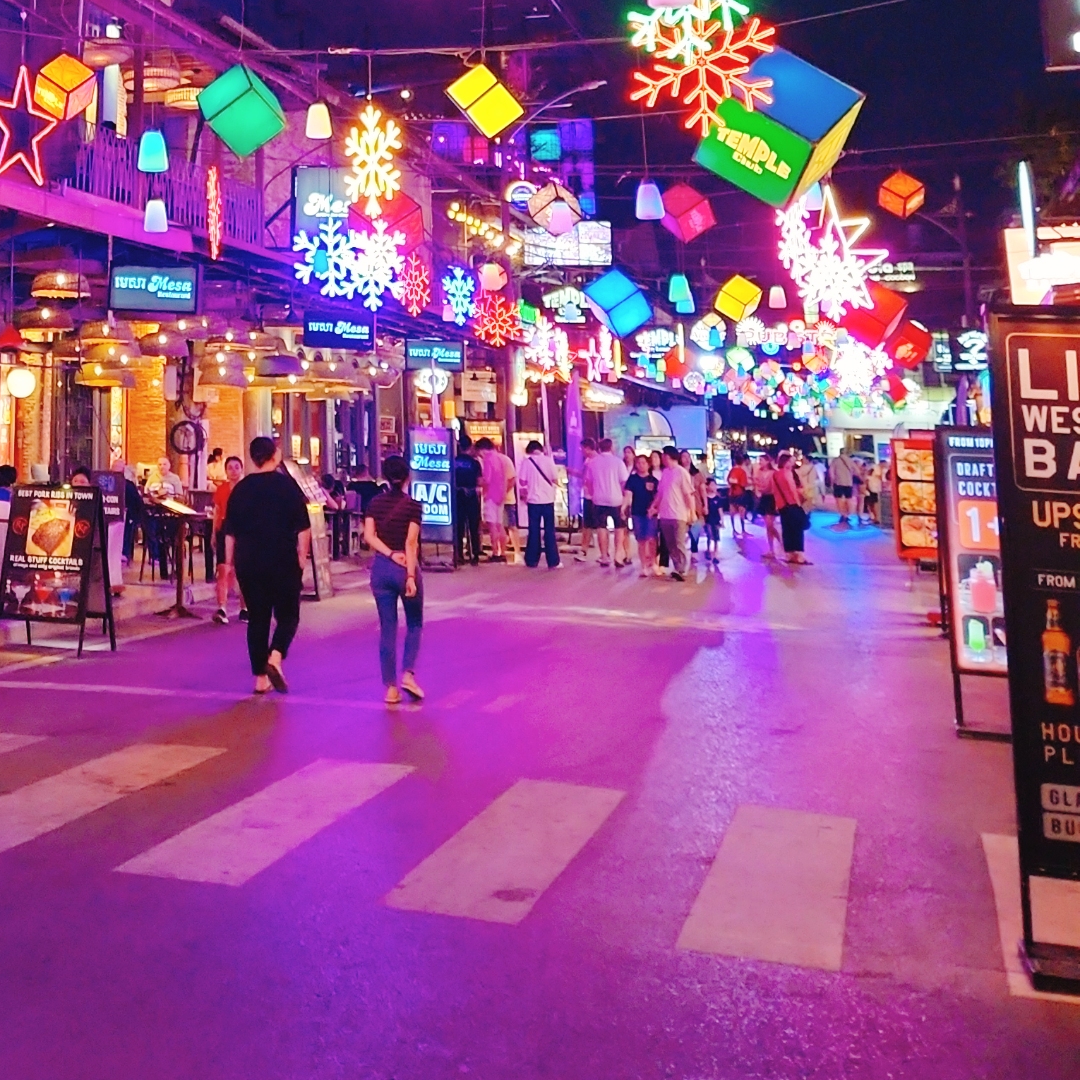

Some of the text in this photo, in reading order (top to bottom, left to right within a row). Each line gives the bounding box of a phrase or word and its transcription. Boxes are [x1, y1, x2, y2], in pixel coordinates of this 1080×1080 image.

[716, 126, 792, 180] TEMPLE
[147, 274, 192, 293] Mesa
[334, 320, 370, 335] Mesa
[431, 347, 461, 360] Mesa
[948, 436, 994, 448] FROM 10P
[410, 455, 451, 470] Mesa
[956, 462, 994, 477] DRAFT
[18, 489, 94, 500] BEST PORK RIBS IN TOWN
[415, 483, 448, 503] A/C
[421, 504, 449, 516] OOM
[9, 554, 26, 563] REAL
[27, 556, 48, 564] STUFF
[1037, 573, 1077, 589] FROM
